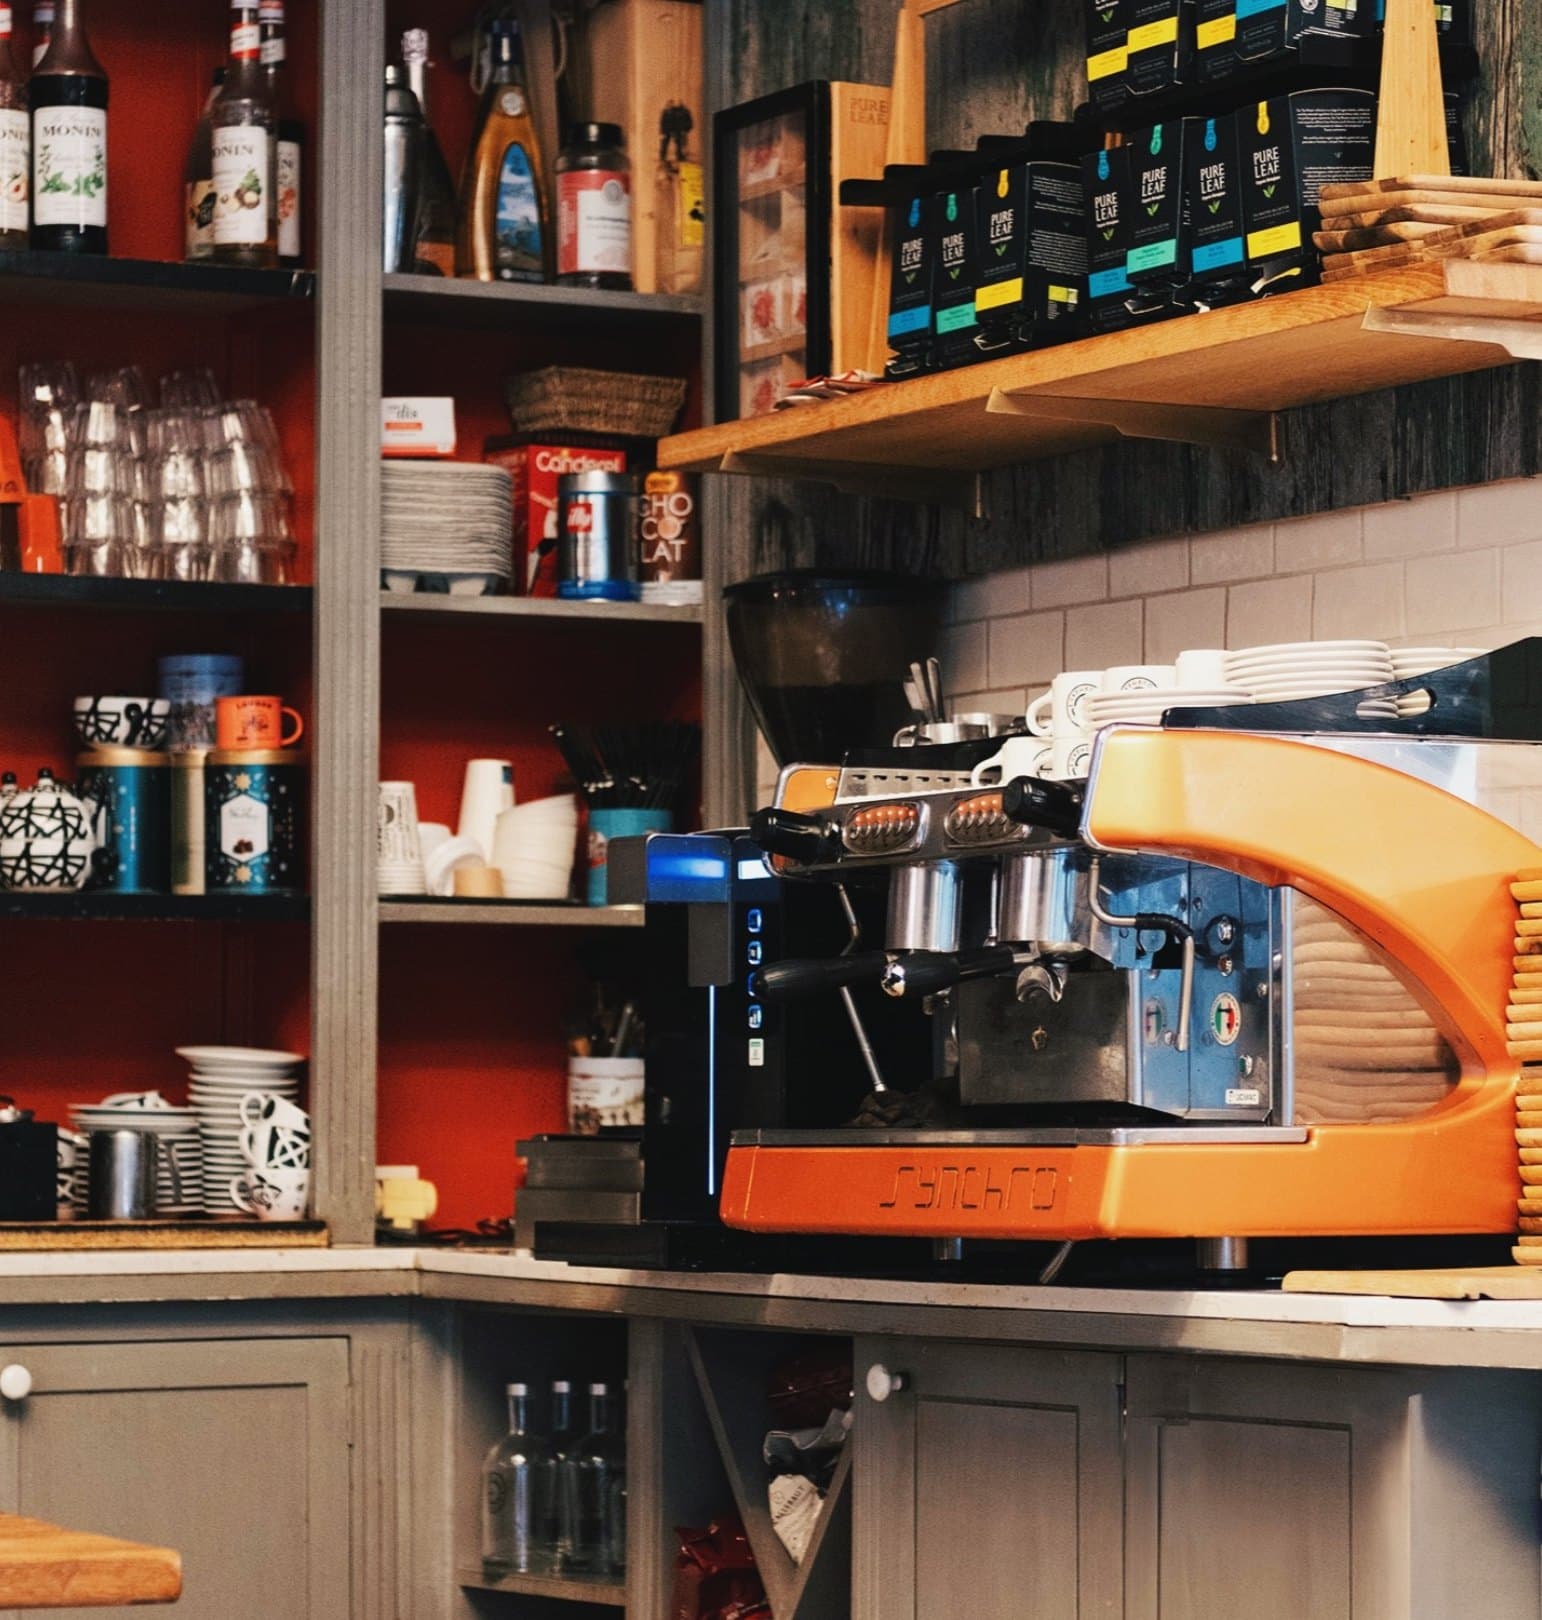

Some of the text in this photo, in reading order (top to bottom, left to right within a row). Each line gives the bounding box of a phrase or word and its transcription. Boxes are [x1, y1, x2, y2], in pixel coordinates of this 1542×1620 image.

[42, 126, 101, 137] MONIN
[1253, 146, 1280, 165] PURE
[1142, 167, 1167, 184] PURE
[1200, 163, 1226, 181] PURE
[1254, 160, 1281, 178] LEAF
[1141, 180, 1167, 197] LEAF
[1200, 177, 1226, 194] LEAF
[1094, 192, 1118, 209] PURE
[990, 209, 1015, 226] PURE
[1095, 205, 1119, 221] LEAF
[989, 222, 1014, 239] LEAF
[902, 237, 924, 254] PURE
[942, 232, 965, 249] PURE
[901, 250, 923, 266] LEAF
[943, 246, 965, 262] LEAF
